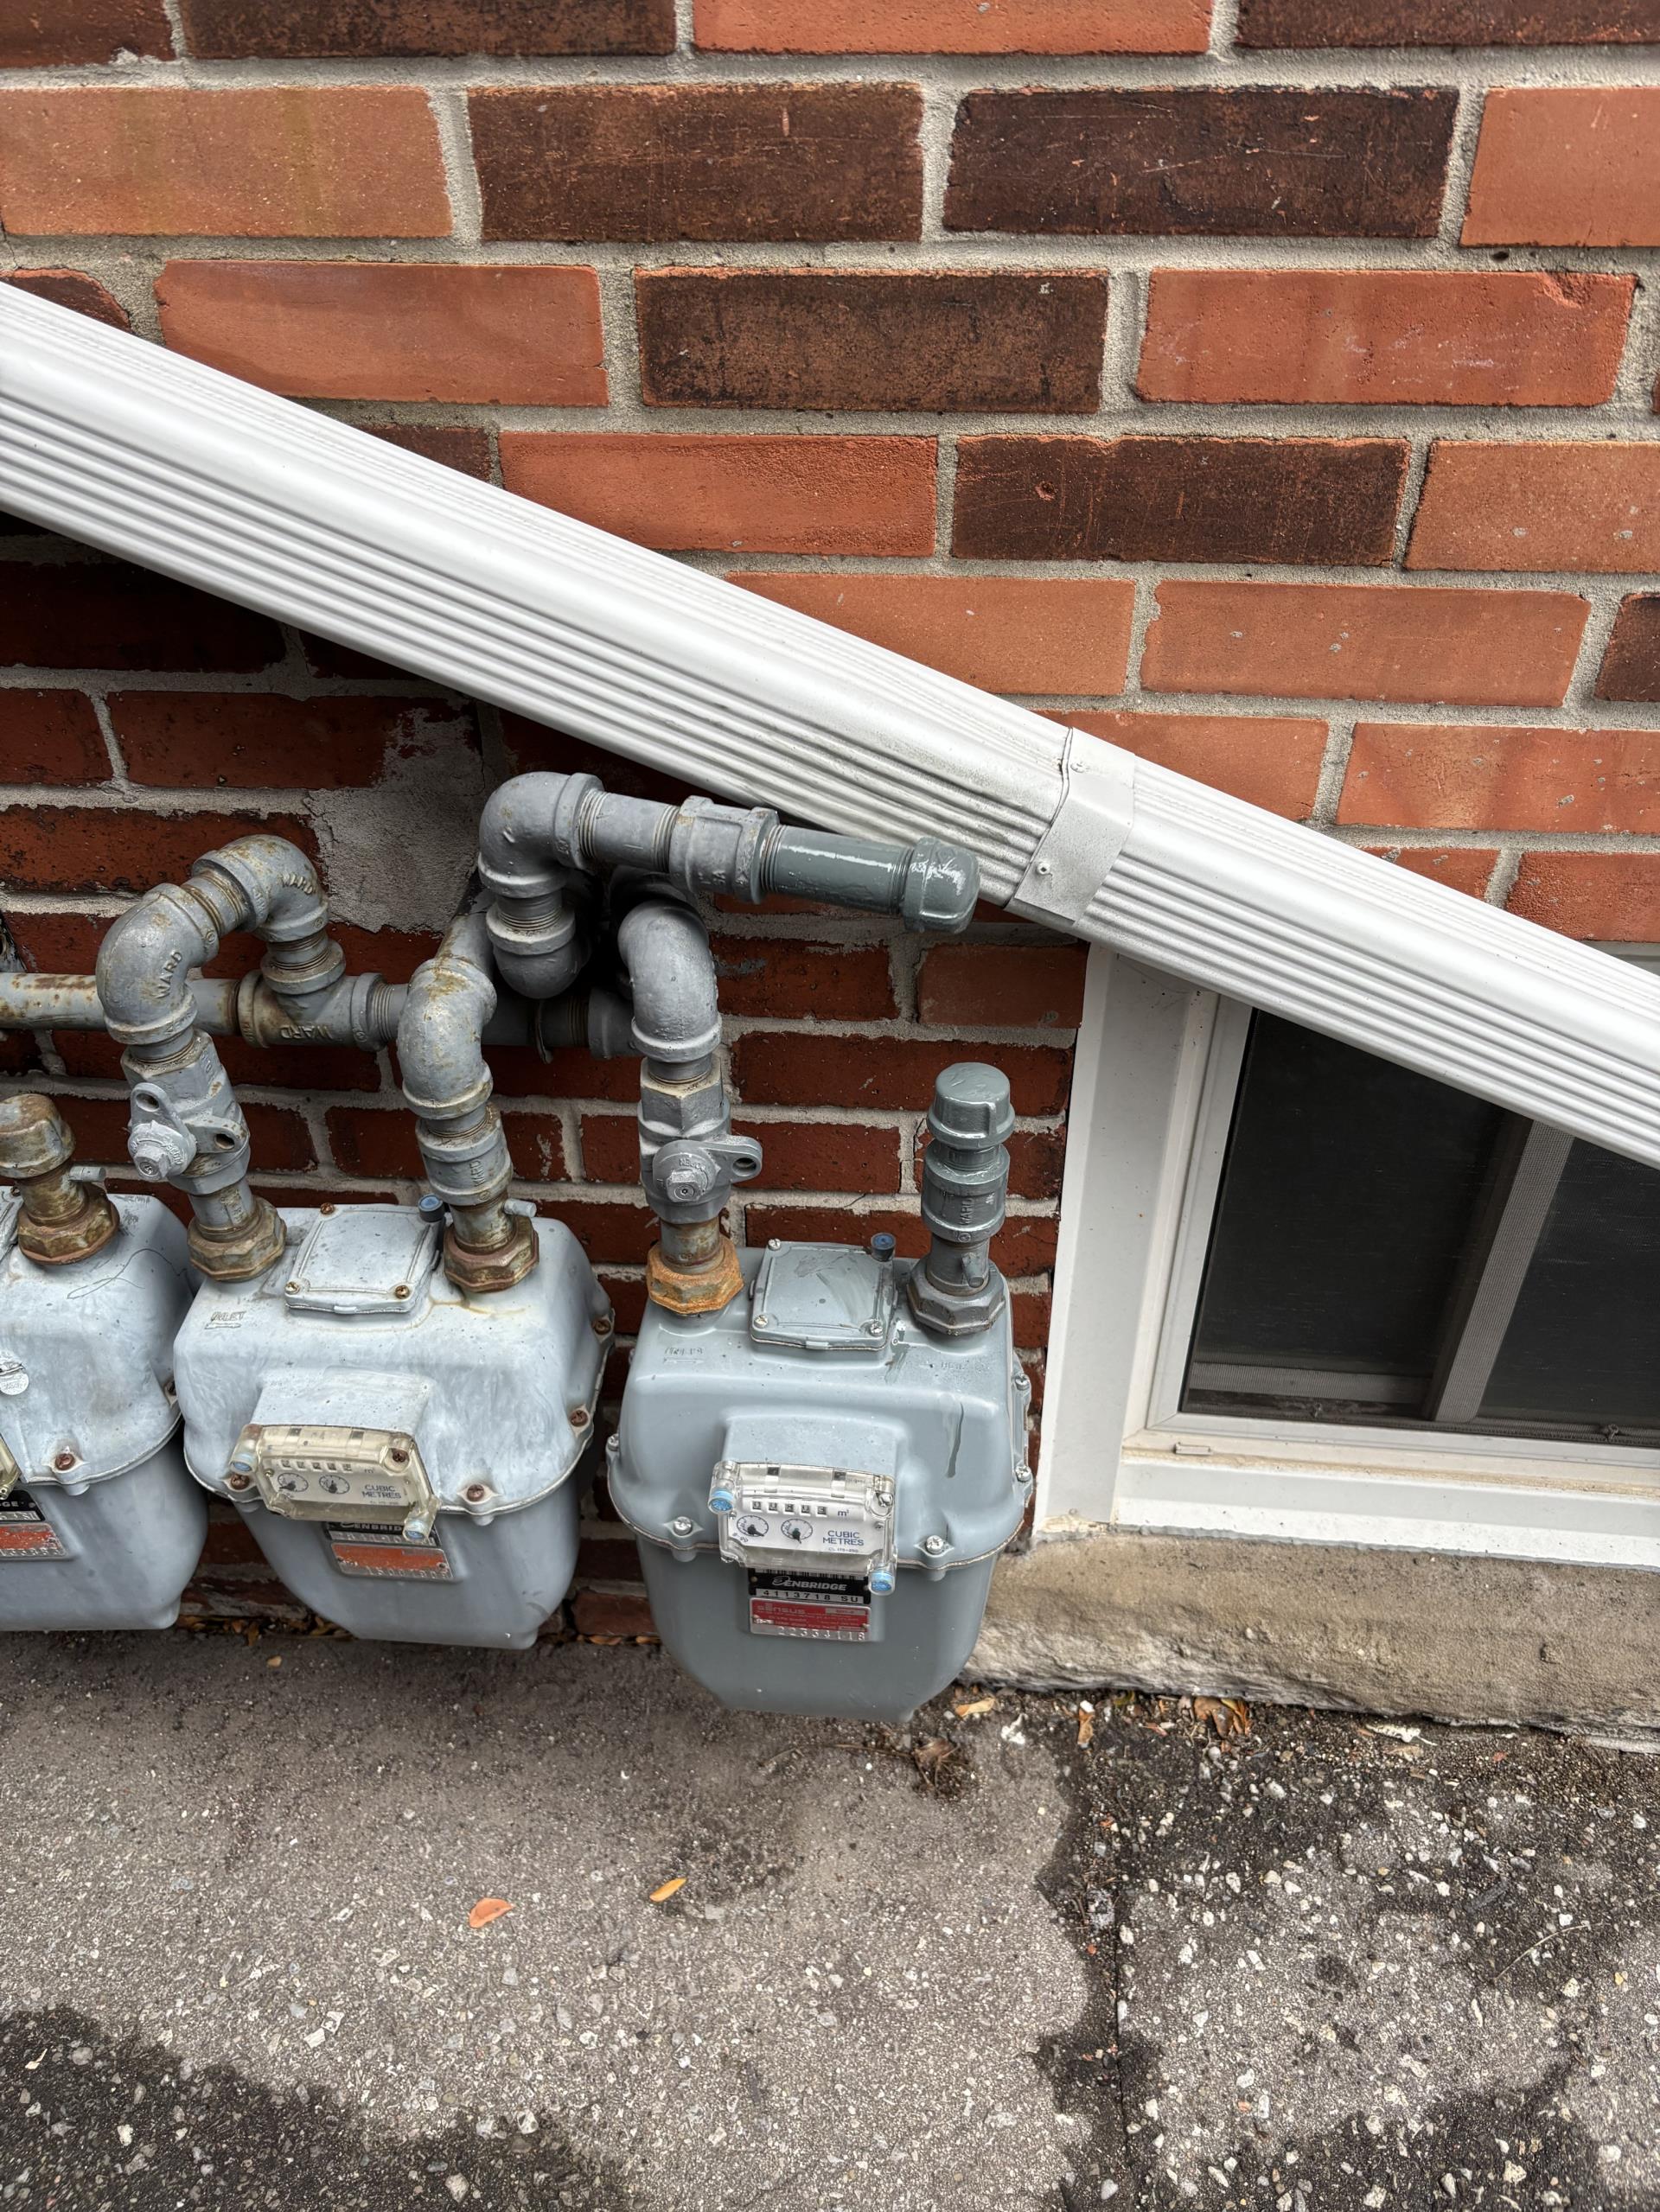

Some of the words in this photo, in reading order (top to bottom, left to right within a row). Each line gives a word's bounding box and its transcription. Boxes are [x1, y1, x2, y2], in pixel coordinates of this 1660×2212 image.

[155, 950, 182, 999] WARD
[280, 1025, 334, 1040] WARD
[469, 1159, 486, 1188] WARD
[364, 1483, 396, 1492] CUBIC
[361, 1490, 402, 1500] METRES
[827, 1529, 860, 1539] CUBIC
[822, 1536, 865, 1546] METRES
[784, 1579, 848, 1591] ENBRIDGE
[763, 1590, 832, 1601] 4113718
[840, 1595, 859, 1603] SU
